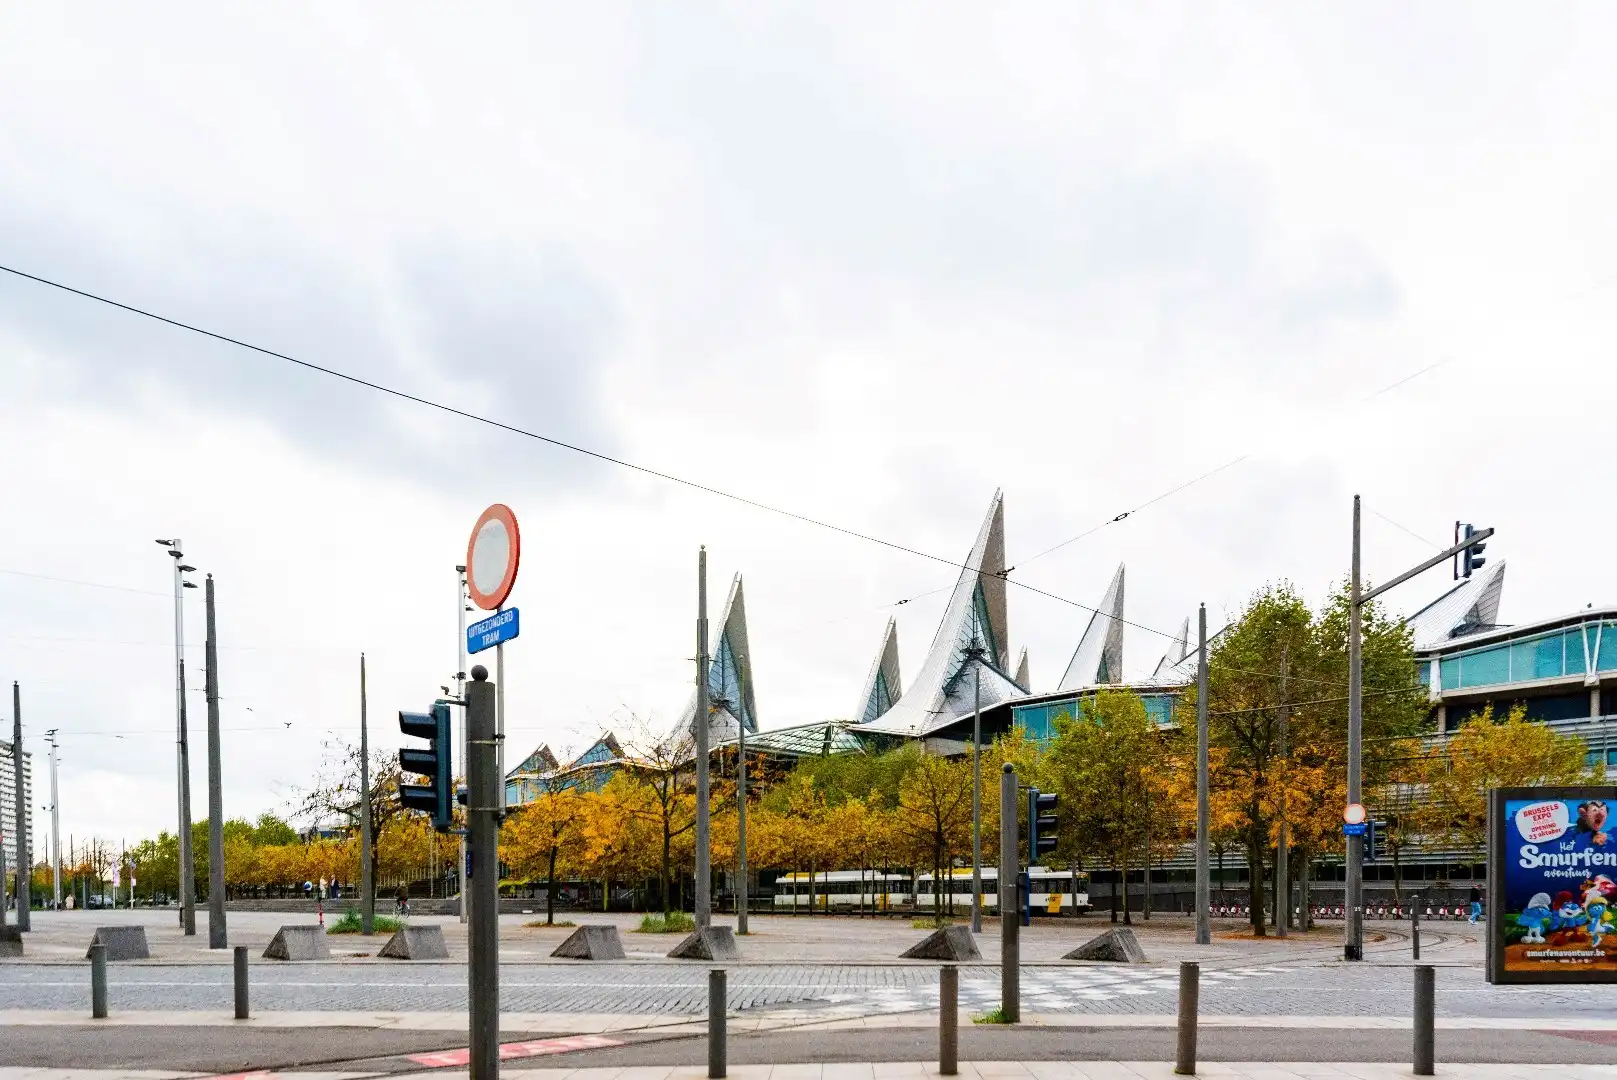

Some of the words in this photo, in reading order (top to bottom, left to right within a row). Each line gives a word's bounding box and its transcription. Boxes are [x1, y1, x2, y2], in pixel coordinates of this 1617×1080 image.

[468, 610, 513, 638] UITGEZONDERD
[482, 629, 500, 646] TRAM
[1523, 803, 1559, 817] BRUSSELS
[1533, 812, 1551, 821] EXPO
[1559, 840, 1576, 852] Het
[1519, 844, 1617, 868] Smurfen
[1543, 866, 1592, 878] avontuur
[1526, 949, 1606, 957] smurfenavontuur.be
